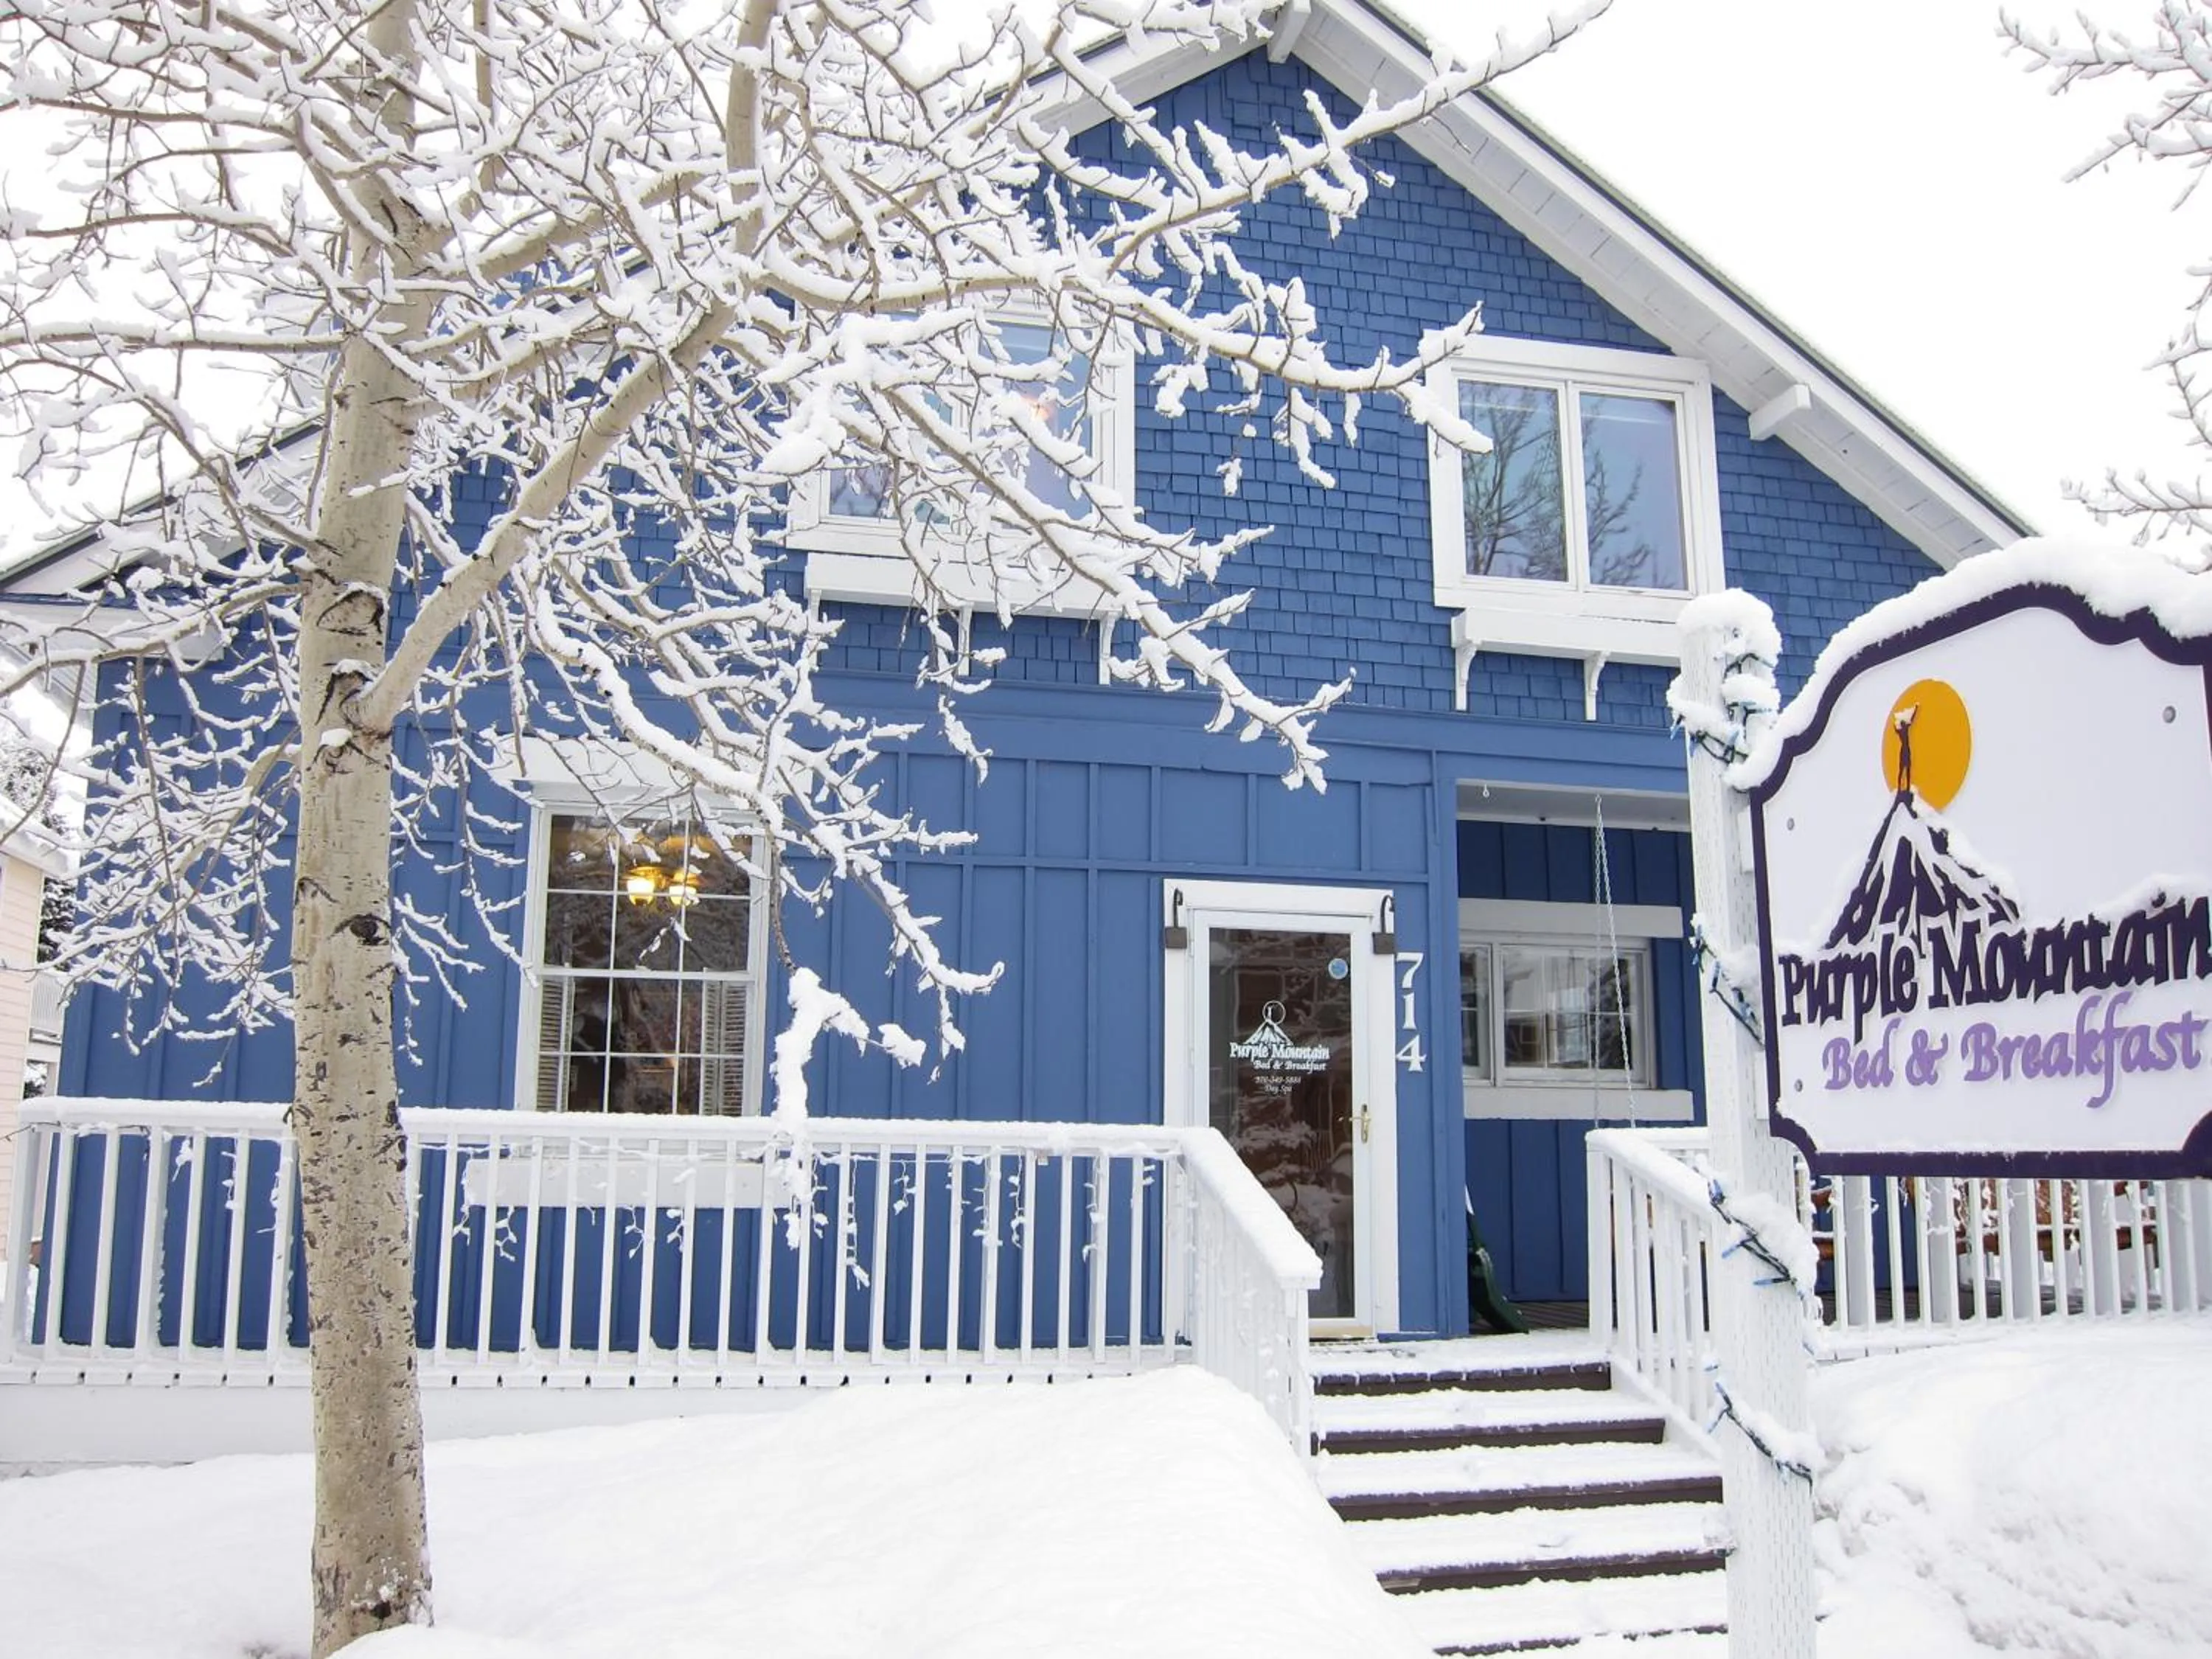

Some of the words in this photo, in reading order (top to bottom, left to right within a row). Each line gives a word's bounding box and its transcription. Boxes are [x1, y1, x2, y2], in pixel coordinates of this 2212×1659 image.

[1395, 952, 1427, 1071] 714
[1778, 933, 1918, 1046] Purple
[1927, 890, 2212, 1009] Mountain
[1230, 1042, 1269, 1062] Purple
[1271, 1044, 1329, 1059] Mountain
[1253, 1058, 1273, 1069] Bed
[1274, 1060, 1284, 1069] &
[1285, 1060, 1327, 1074] Breakfast
[1822, 1018, 1902, 1091] Bed
[1905, 1029, 1948, 1088] &
[1961, 991, 2209, 1108] Breakfast
